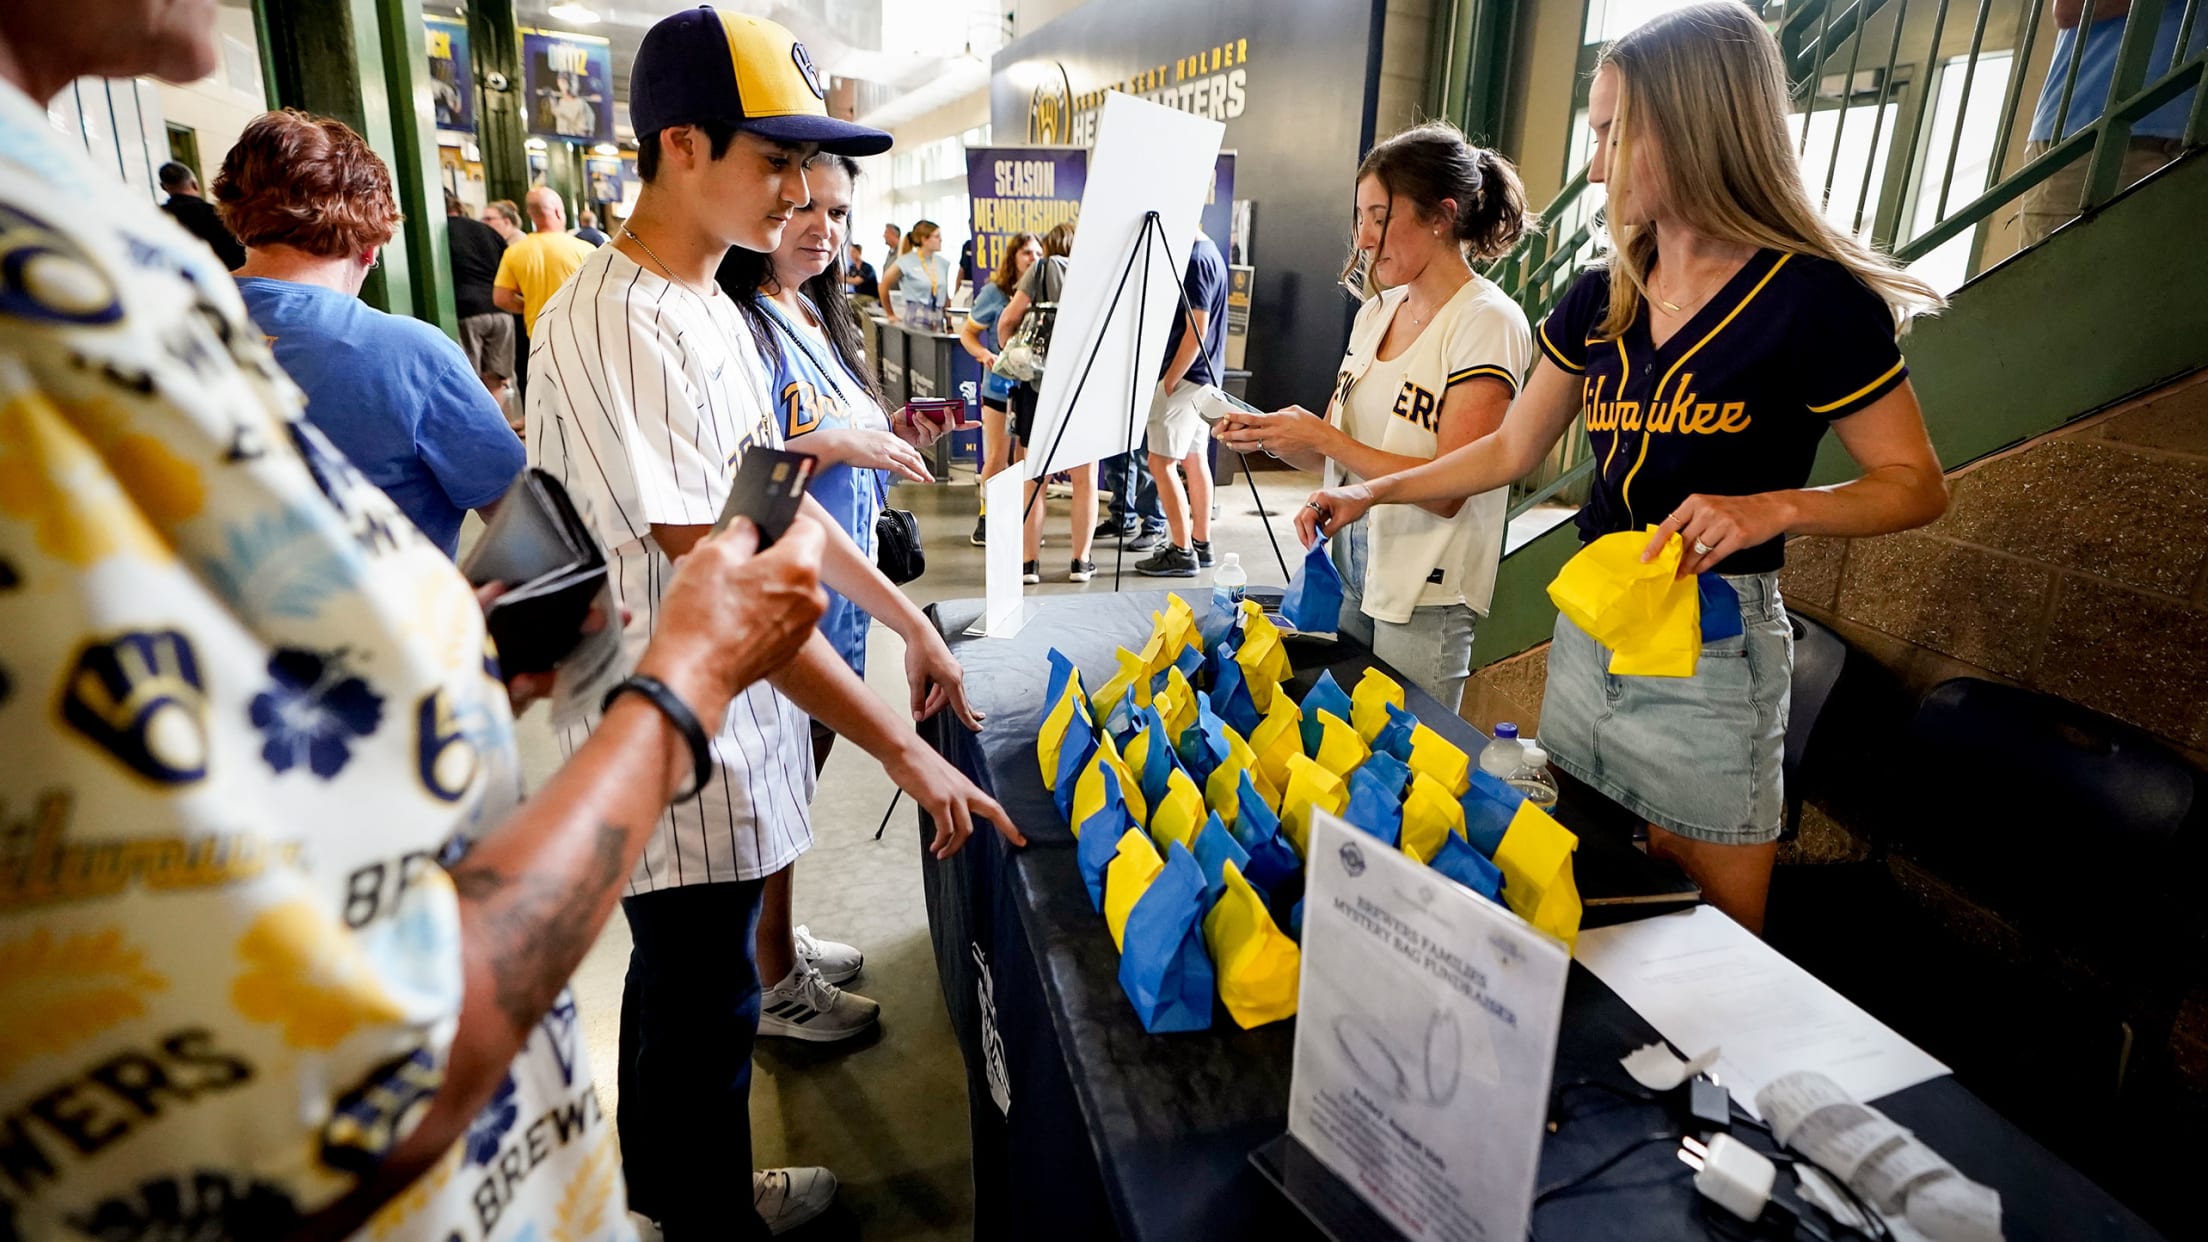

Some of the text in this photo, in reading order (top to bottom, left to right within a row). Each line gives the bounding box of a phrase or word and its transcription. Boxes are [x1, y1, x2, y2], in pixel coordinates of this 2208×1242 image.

[1129, 65, 1168, 95] SEAT
[1176, 38, 1248, 82] HOLDER
[994, 160, 1056, 198] SEASON
[973, 197, 1079, 233] MEMBERSHIPS
[976, 233, 988, 269] &
[1583, 373, 1752, 435] ilwaukee
[1333, 897, 1392, 944] MYSTERY
[1423, 954, 1518, 1030] FUNDRAISER
